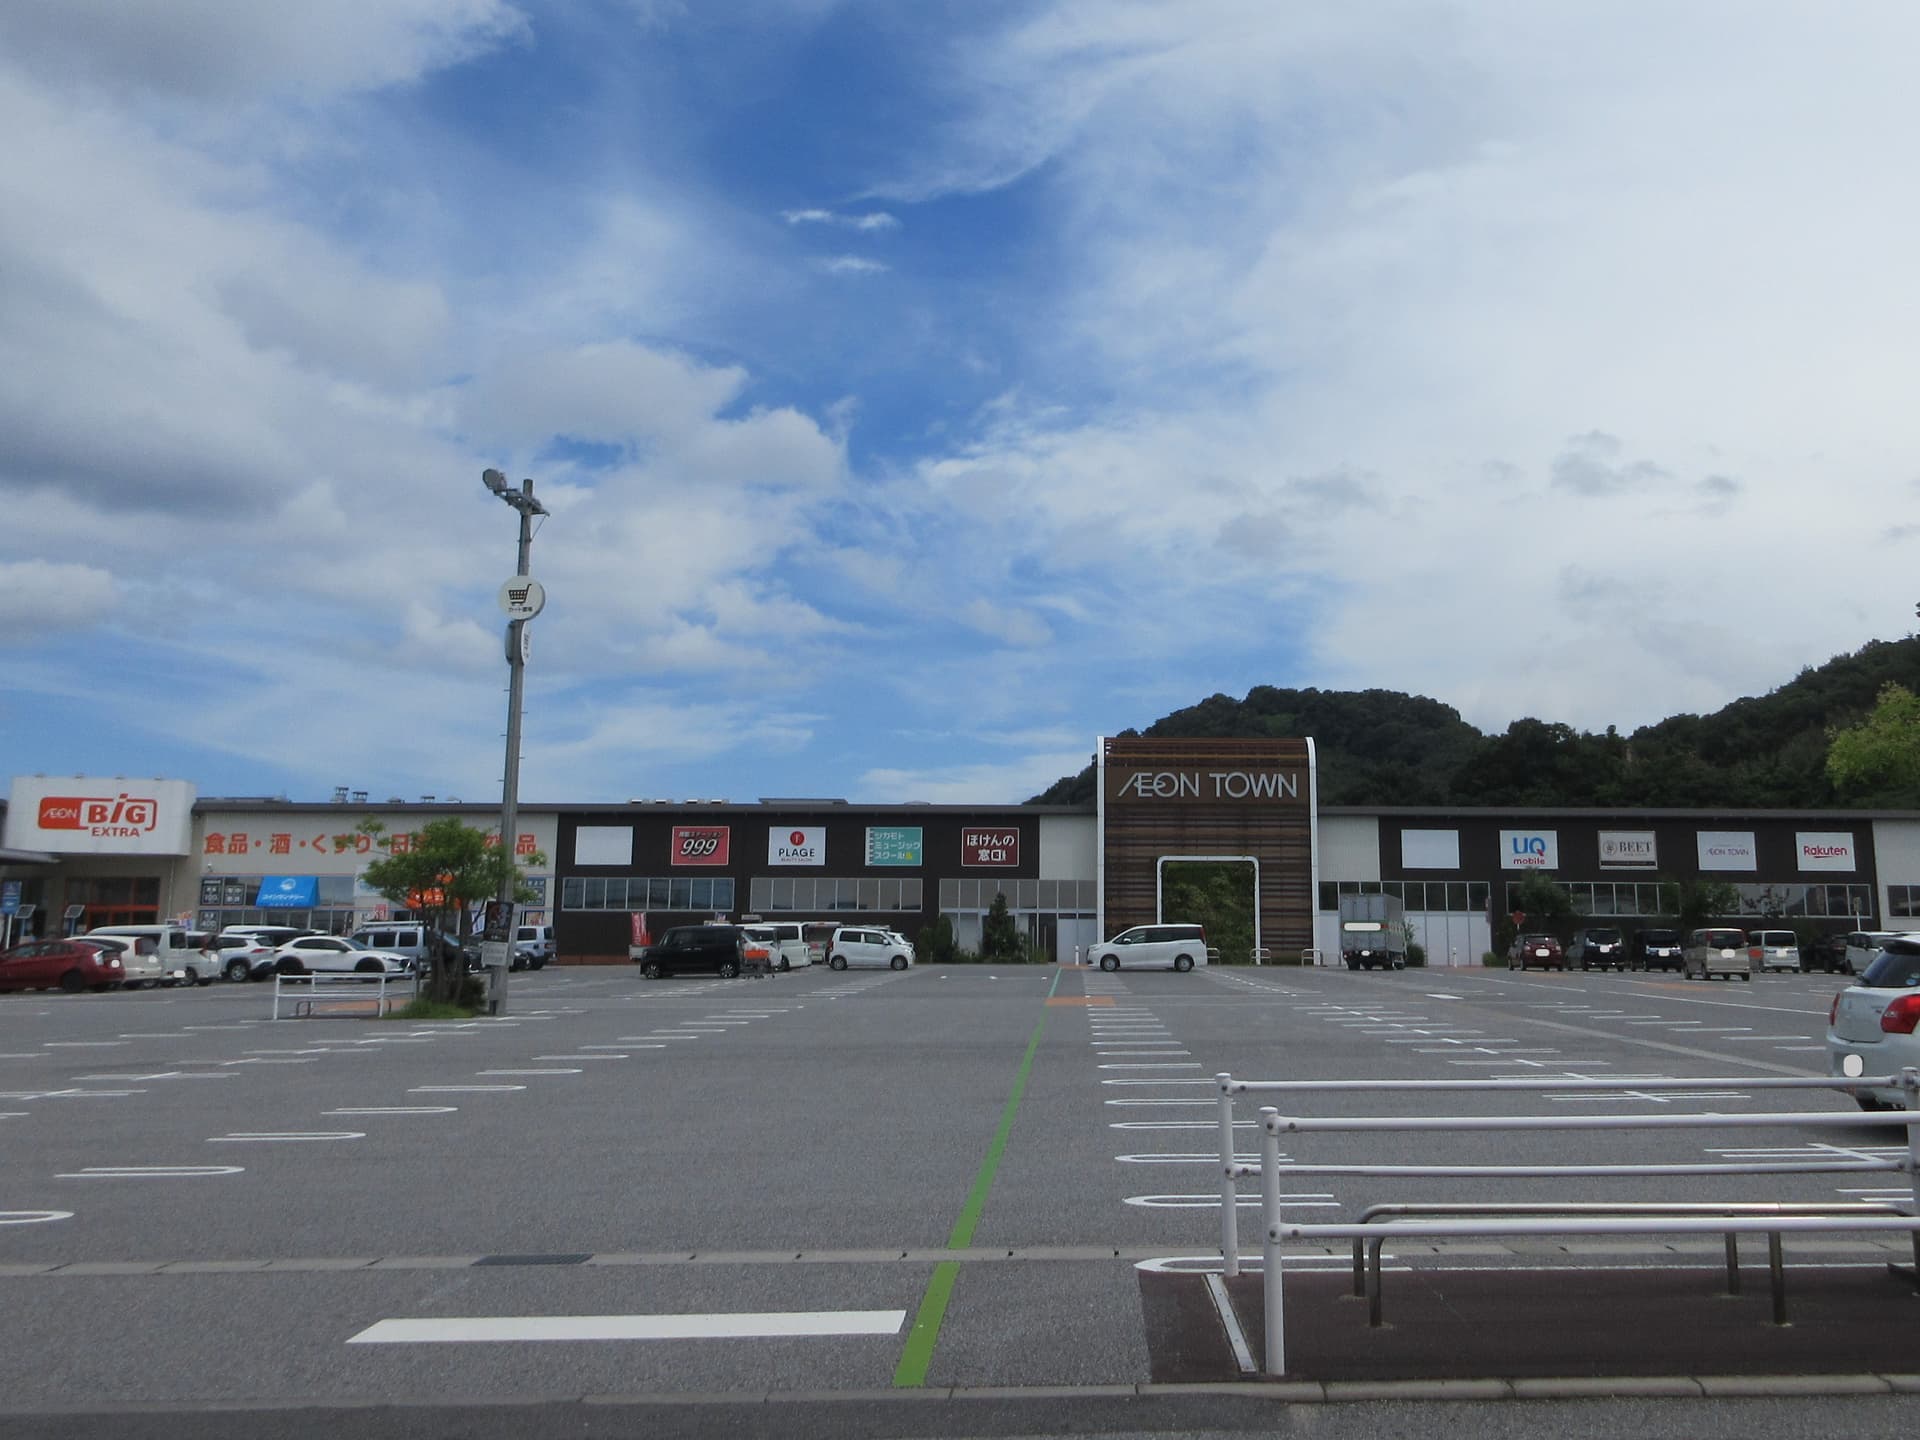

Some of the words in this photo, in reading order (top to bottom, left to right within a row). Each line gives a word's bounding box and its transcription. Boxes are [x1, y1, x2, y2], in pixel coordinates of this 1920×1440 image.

[1209, 771, 1297, 798] TOWN
[91, 827, 141, 837] EXTRA
[967, 833, 1015, 847] ほけんの
[680, 838, 718, 856] 999
[874, 841, 921, 850] ミュージック
[1512, 837, 1546, 856] UQ
[1803, 845, 1848, 856] Rakuten
[778, 848, 815, 857] PLAGE
[874, 851, 905, 860] スクール
[978, 848, 1006, 862] 窓口
[1727, 848, 1749, 856] TOWN
[1513, 857, 1545, 865] mobile
